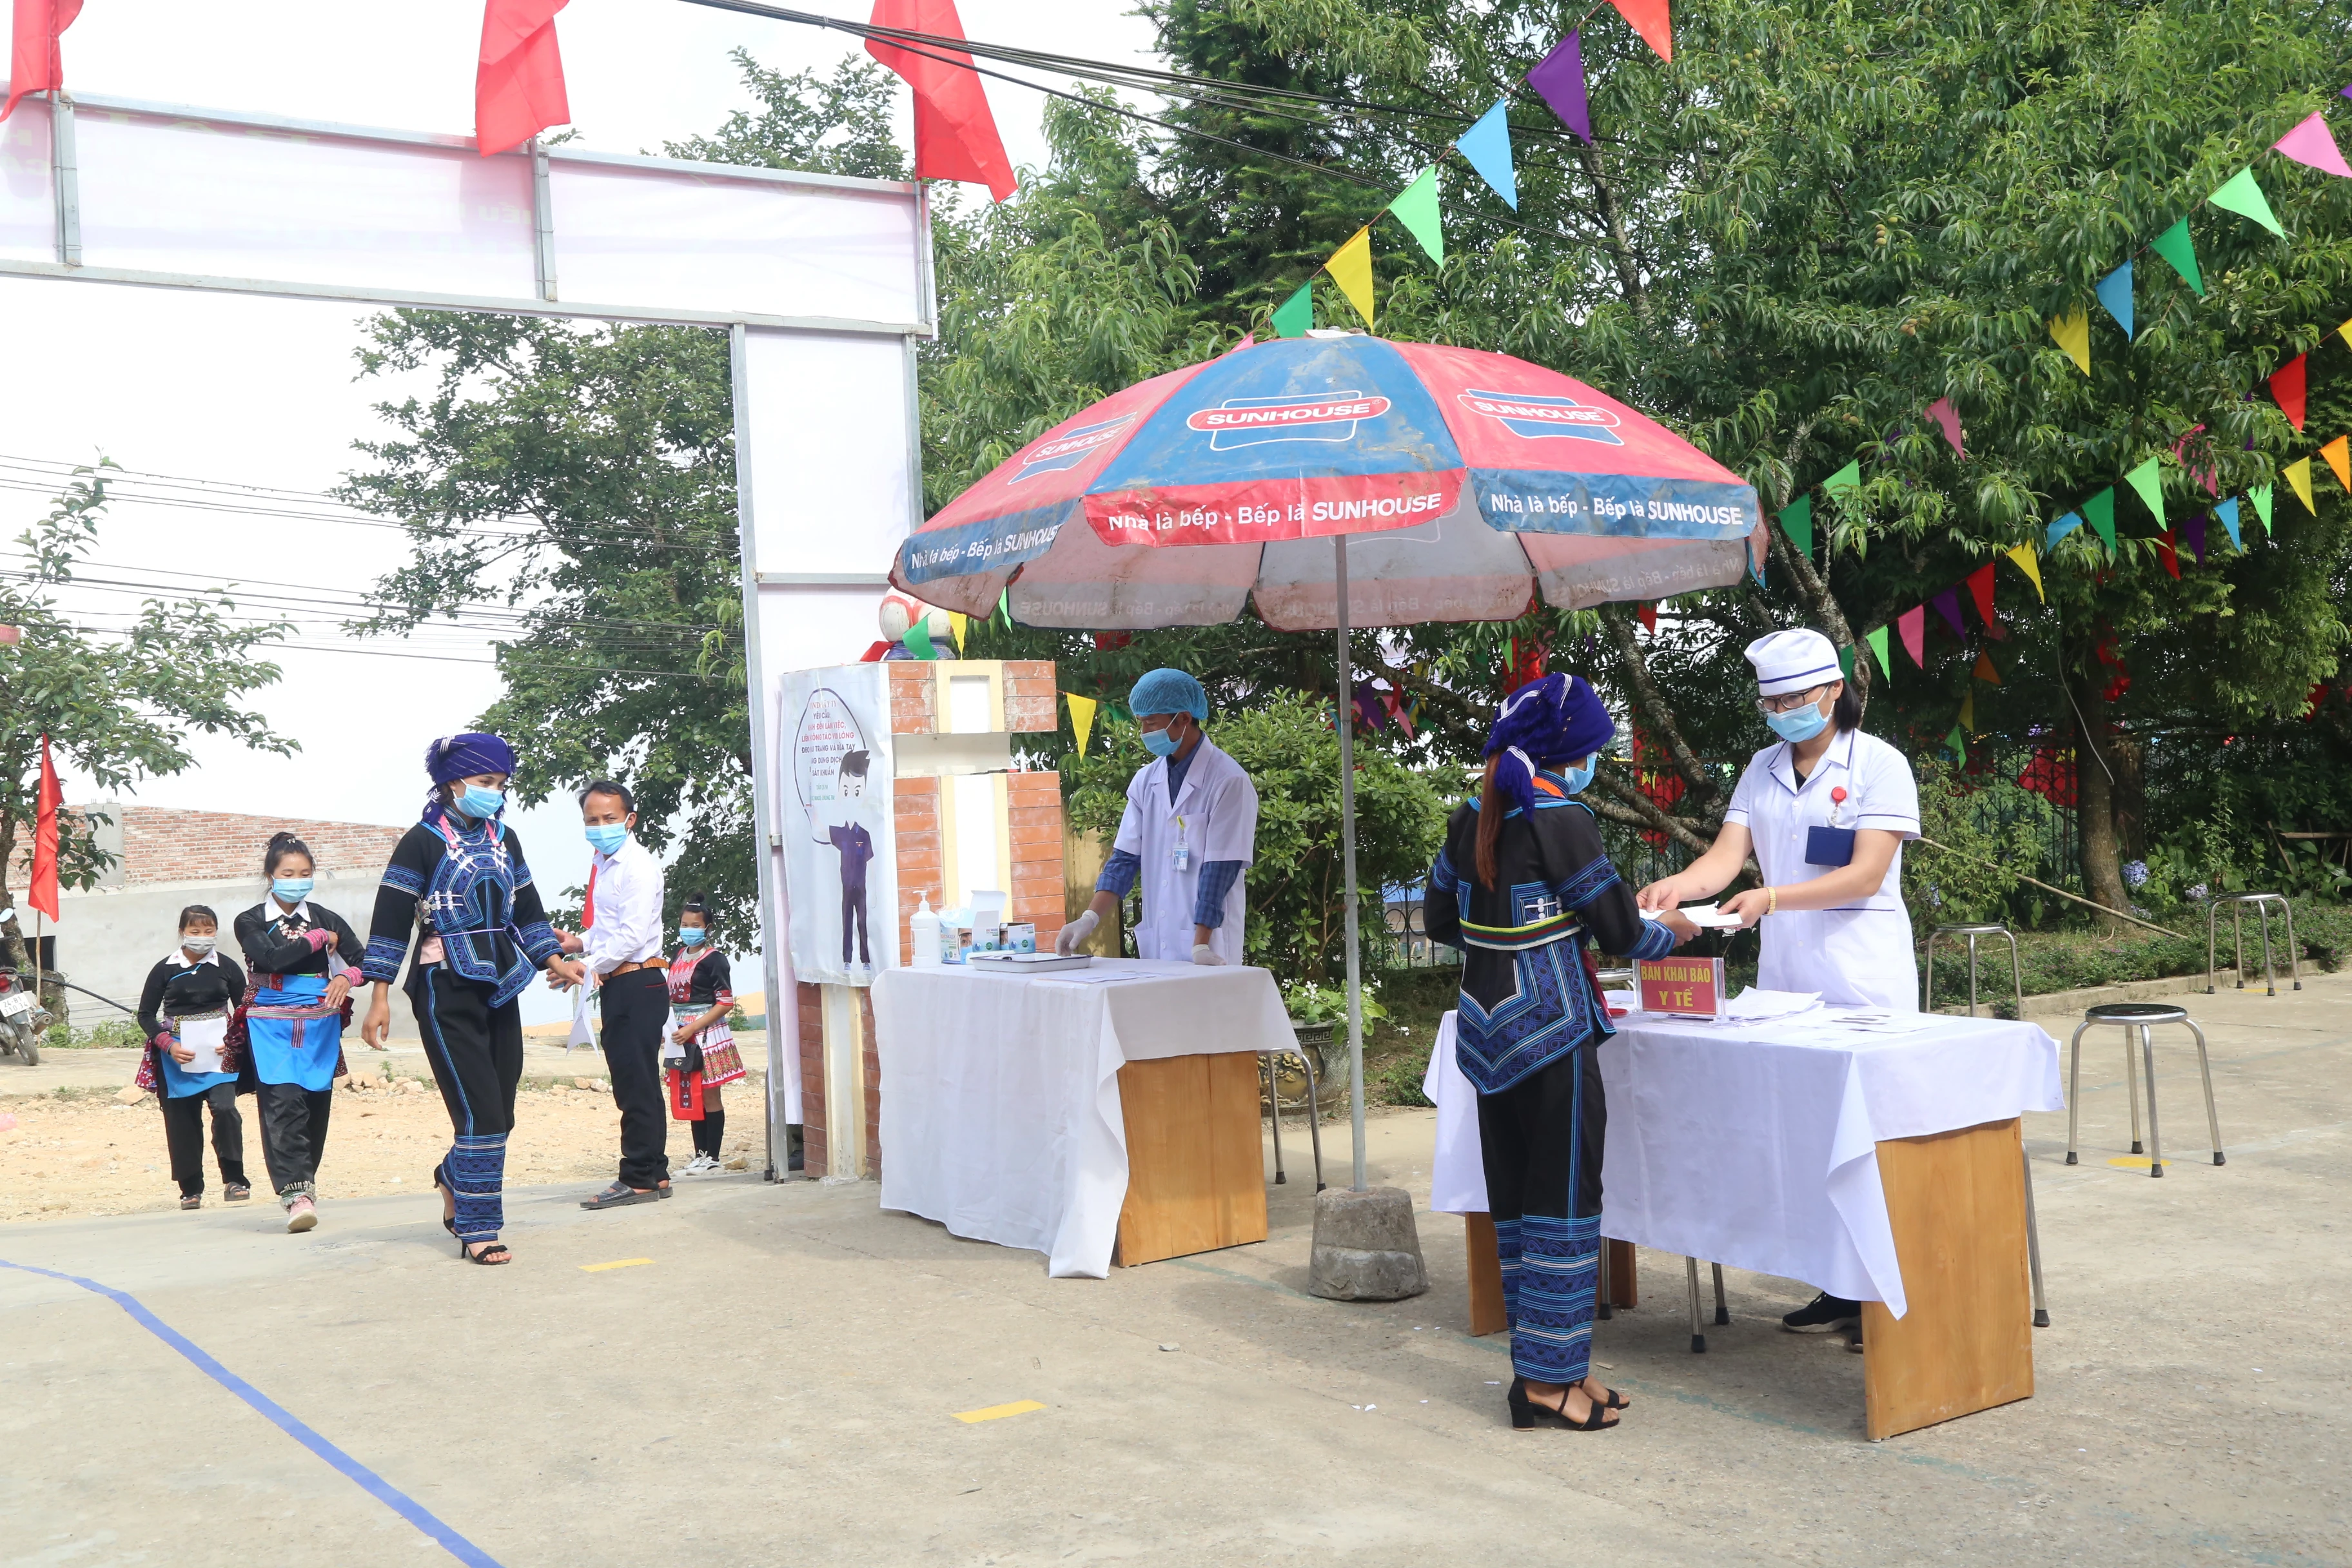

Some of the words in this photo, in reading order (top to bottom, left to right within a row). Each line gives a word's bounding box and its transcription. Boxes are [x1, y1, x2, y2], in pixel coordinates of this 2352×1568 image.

[1206, 402, 1371, 425] SUNHOUSE
[1473, 400, 1605, 422] SUNHOUSE
[1108, 514, 1150, 531] Nhà
[1155, 511, 1173, 531] là
[1179, 504, 1218, 529] bếp
[1237, 502, 1280, 526] Bếp
[1288, 503, 1306, 522] là
[1312, 493, 1442, 522] SUNHOUSE
[1491, 493, 1524, 513] Nhà
[1527, 495, 1544, 513] là
[1547, 493, 1578, 518] bếp
[1593, 496, 1627, 520] Bếp
[1629, 500, 1645, 517] là
[1647, 500, 1743, 525] SUNHOUSE
[939, 543, 960, 564] bếp
[966, 538, 993, 561] Bếp
[994, 538, 1002, 555] là
[813, 710, 821, 720] YÊU
[839, 730, 855, 739] LÒNG
[830, 743, 836, 751] VÀ
[1641, 963, 1661, 981] BÀN
[1663, 966, 1687, 982] KHAI
[1690, 965, 1711, 983] BÁO
[1658, 990, 1669, 1006] Y
[1673, 986, 1694, 1007] TẾ
